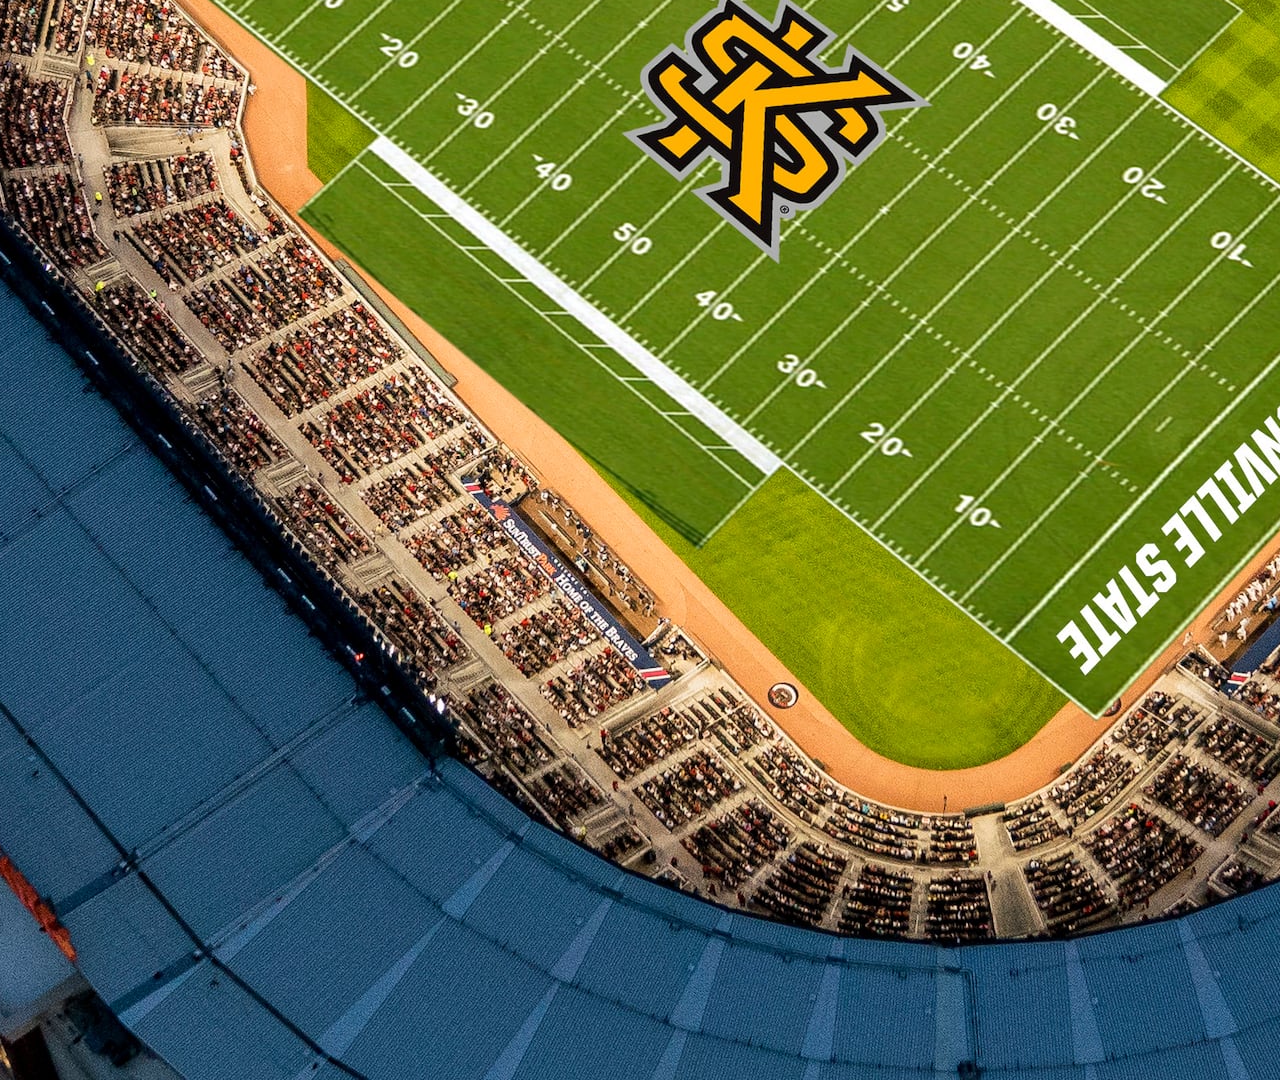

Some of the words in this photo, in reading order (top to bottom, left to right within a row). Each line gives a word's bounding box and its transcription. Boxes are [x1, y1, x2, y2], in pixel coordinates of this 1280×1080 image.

[380, 38, 419, 69] 20
[953, 42, 991, 70] 40
[457, 98, 495, 129] 30
[1037, 103, 1076, 135] 30
[535, 162, 572, 191] 40
[1123, 167, 1165, 198] 20
[613, 222, 652, 255] 50
[1211, 231, 1246, 261] 10
[695, 290, 733, 320] 40
[777, 354, 817, 387] 30
[860, 422, 903, 456] 20
[955, 494, 991, 527] 10
[555, 573, 582, 605] HOME
[580, 600, 593, 617] OF
[590, 613, 608, 632] THE
[605, 627, 638, 662] BRAVES
[1056, 543, 1177, 676] STATE
